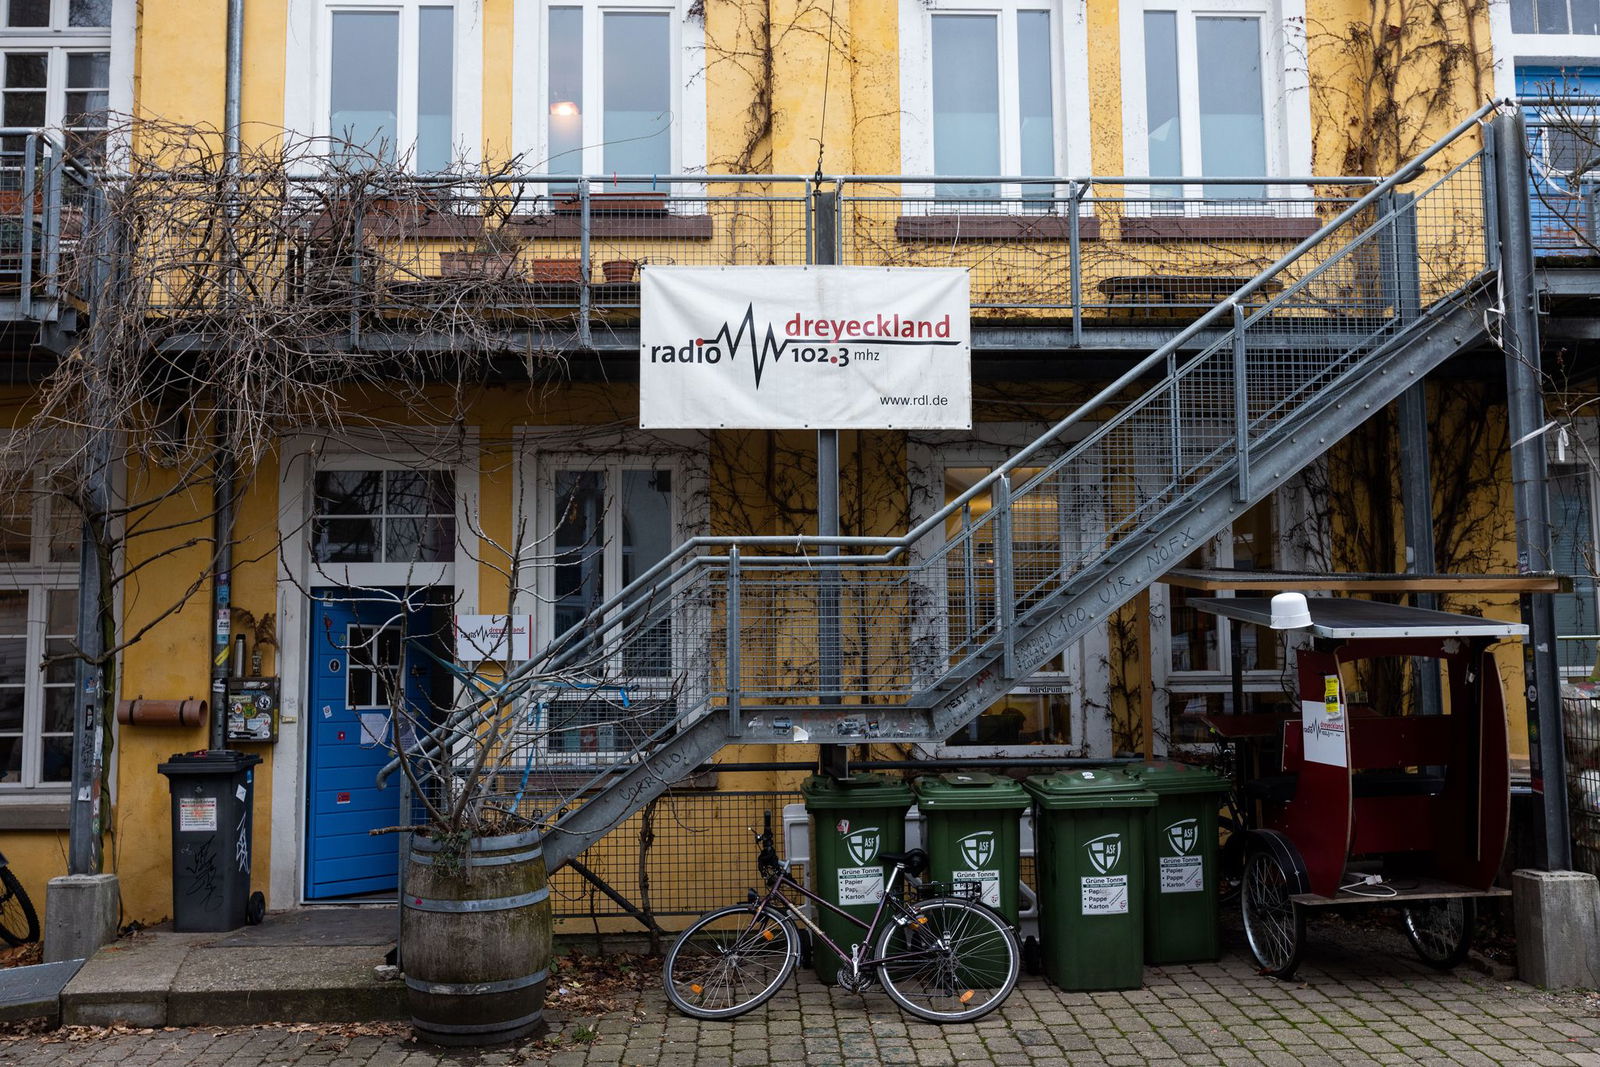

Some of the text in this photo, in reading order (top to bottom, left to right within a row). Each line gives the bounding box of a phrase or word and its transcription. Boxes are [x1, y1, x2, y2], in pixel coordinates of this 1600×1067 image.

[785, 312, 950, 340] dreyeckland
[651, 338, 722, 364] radio
[792, 348, 880, 367] 102.3 mhz
[880, 394, 948, 406] www.rdl.de
[1146, 528, 1195, 573] NOFX
[944, 688, 968, 713] TEST
[1184, 828, 1193, 838] ASF
[864, 838, 874, 847] ASF
[979, 842, 989, 851] ASF
[1106, 844, 1116, 854] ASF
